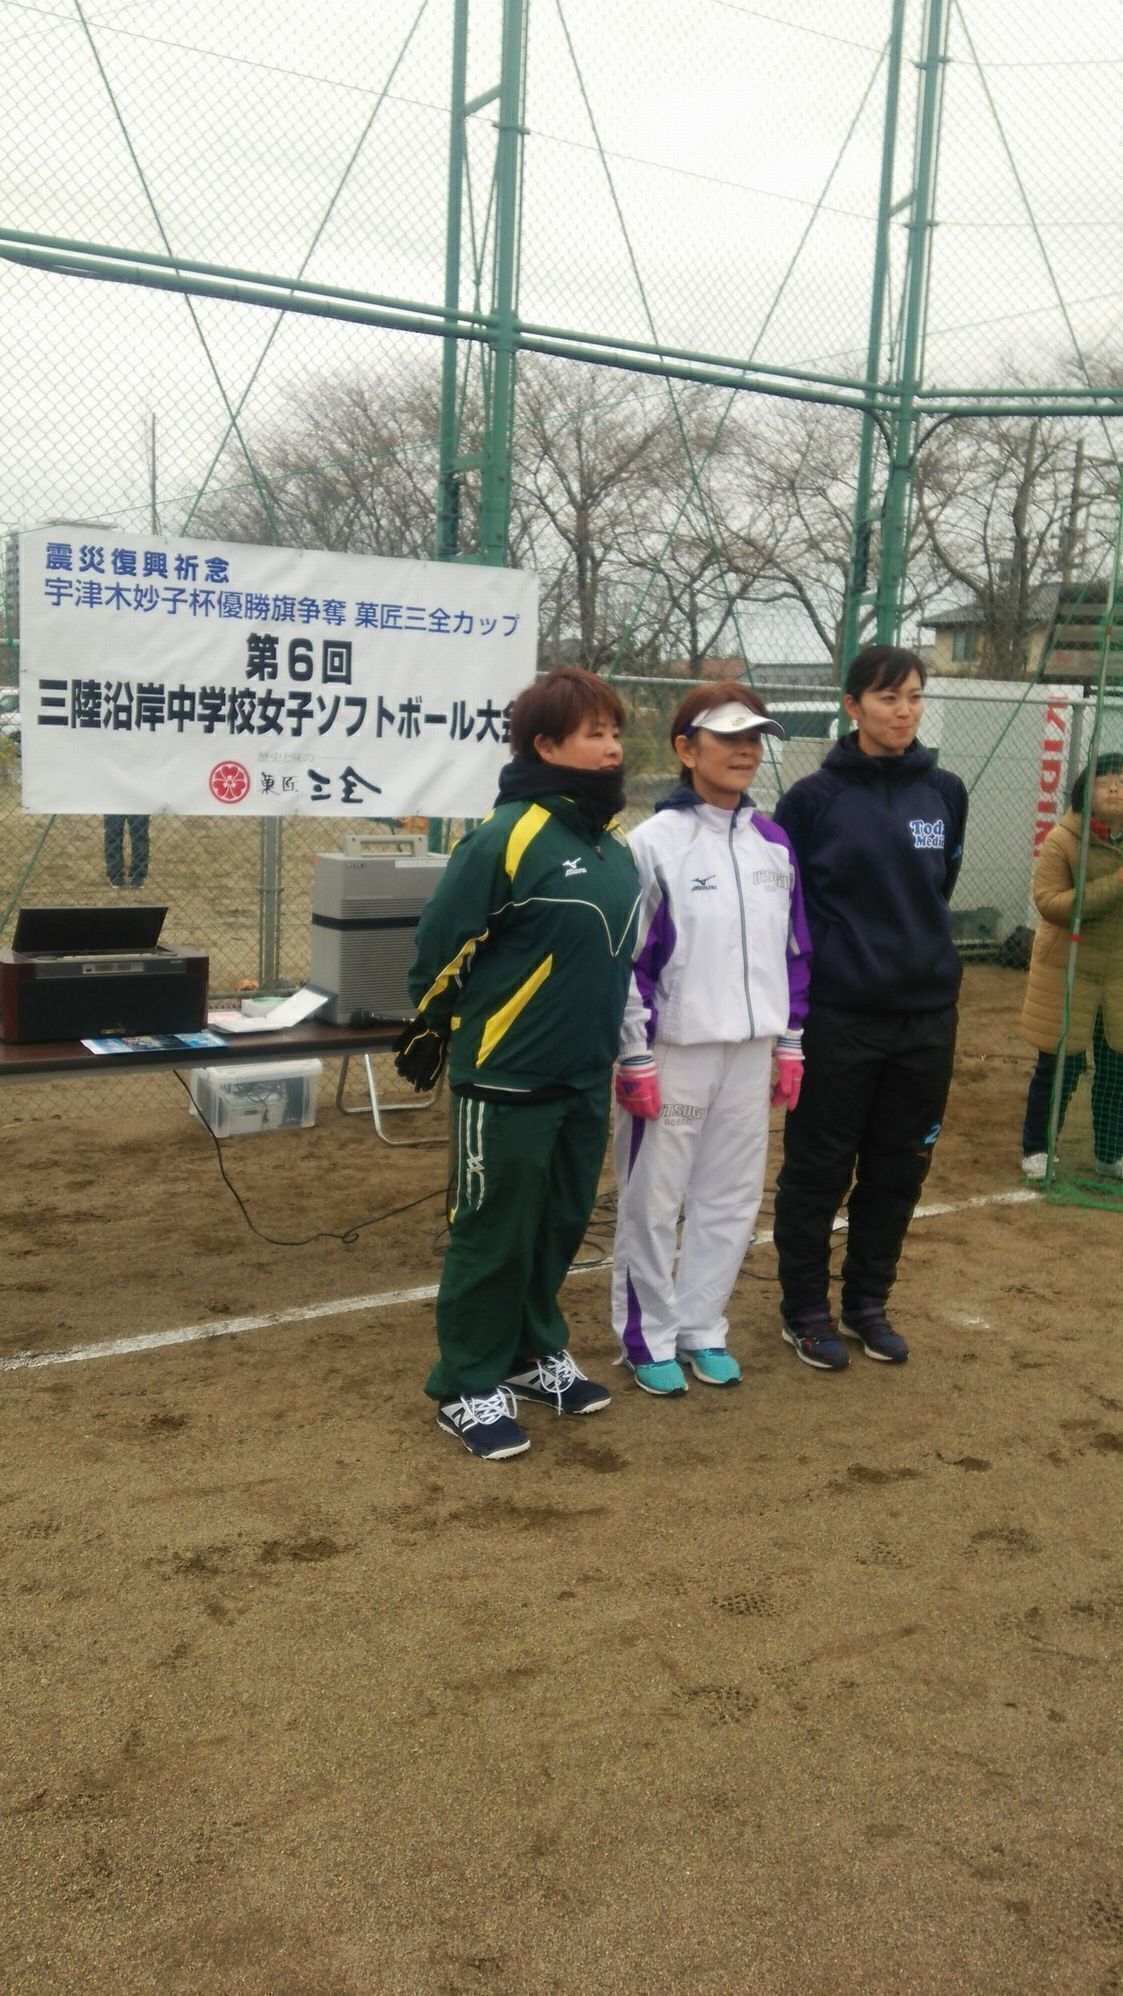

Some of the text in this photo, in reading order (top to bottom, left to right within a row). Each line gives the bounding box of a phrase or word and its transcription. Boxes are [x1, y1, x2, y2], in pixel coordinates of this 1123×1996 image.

[45, 541, 230, 583] 震災復興祈念
[44, 577, 521, 637] 宇津木妙子杯優勝旗争奪 菓匠三全カップ
[245, 632, 353, 685] 第6回
[910, 819, 944, 836] Tod
